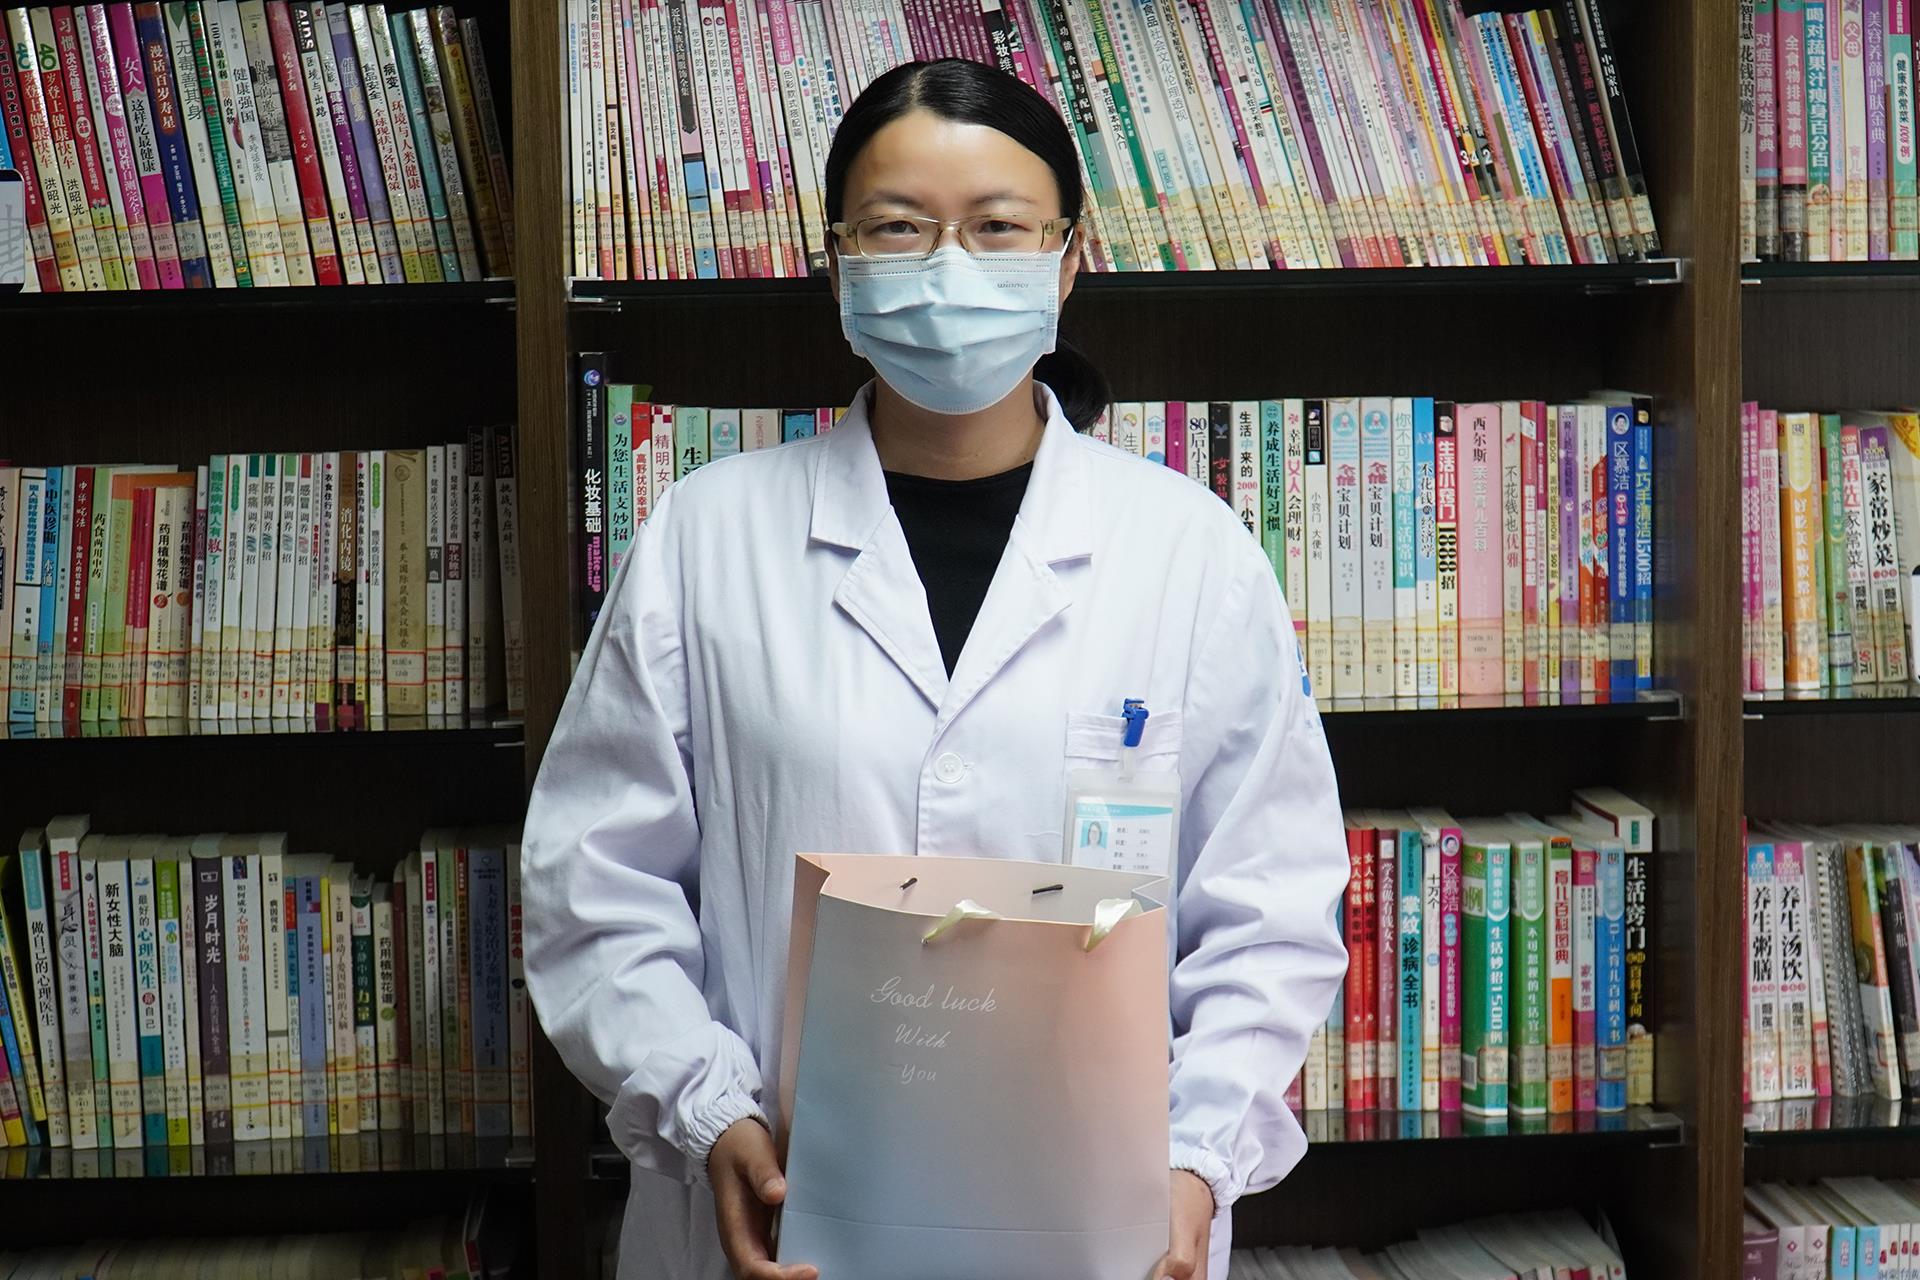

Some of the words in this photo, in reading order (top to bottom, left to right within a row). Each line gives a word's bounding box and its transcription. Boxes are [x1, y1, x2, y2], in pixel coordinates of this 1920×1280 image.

[124, 57, 143, 86] 女人
[1142, 0, 1189, 122] 食品社会文化伦理透视
[1843, 22, 1861, 57] 父母
[149, 45, 176, 130] 漫话百岁寿星
[175, 40, 202, 119] 无毒善其身
[231, 66, 257, 123] 健康强国
[1756, 33, 1775, 152] 对症药膳养生事典
[1806, 8, 1829, 168] 喝对蔬果汁瘦身百分百
[1867, 11, 1886, 144] 美容养颜护肤金典
[131, 99, 157, 172] 这样吃最健康
[390, 99, 423, 189] 环境与人类健康
[1460, 150, 1470, 164] 3
[1470, 150, 1480, 164] 4
[1482, 149, 1493, 164] 2
[44, 177, 63, 214] 洪昭光
[66, 178, 85, 214] 洪昭光
[584, 468, 602, 533] 化妆基础
[1265, 421, 1287, 532] 养成生活好习惯
[1287, 429, 1308, 542] 幸福女人会理财
[1395, 412, 1414, 578] 你不可不知的生活常识
[1438, 440, 1457, 519] 生活小窍门
[1613, 442, 1629, 490] 区慕洁
[91, 513, 105, 579] 药食两用中药
[340, 507, 354, 572] 消化内镜
[1418, 463, 1435, 558] 不花钱的经济学
[1503, 465, 1519, 569] 不花钱也优雅
[1867, 471, 1893, 568] 家常炒菜
[156, 522, 172, 592] 药用植物花谱
[179, 521, 193, 594] 药用植物花谱
[104, 883, 125, 957] 新女性大脑
[269, 899, 285, 938] 病因何在
[1381, 862, 1396, 955] 学会做有钱女人
[1440, 864, 1460, 914] 区慕洁
[1553, 869, 1571, 965] 育儿百科图典
[1627, 858, 1647, 949] 生活窍门
[204, 893, 222, 964] 岁月时光
[1401, 895, 1421, 1009] 掌纹诊病全书
[1751, 885, 1773, 983] 养生粥膳
[1780, 885, 1803, 983] 养生汤饮
[31, 920, 56, 1027] 做自己的心理医生
[378, 935, 395, 1004] 药用植物花谱
[871, 976, 935, 1009] Good
[941, 986, 997, 1013] luck
[1579, 964, 1594, 1008] 家常菜
[895, 1024, 951, 1049] With
[887, 1063, 936, 1084] You
